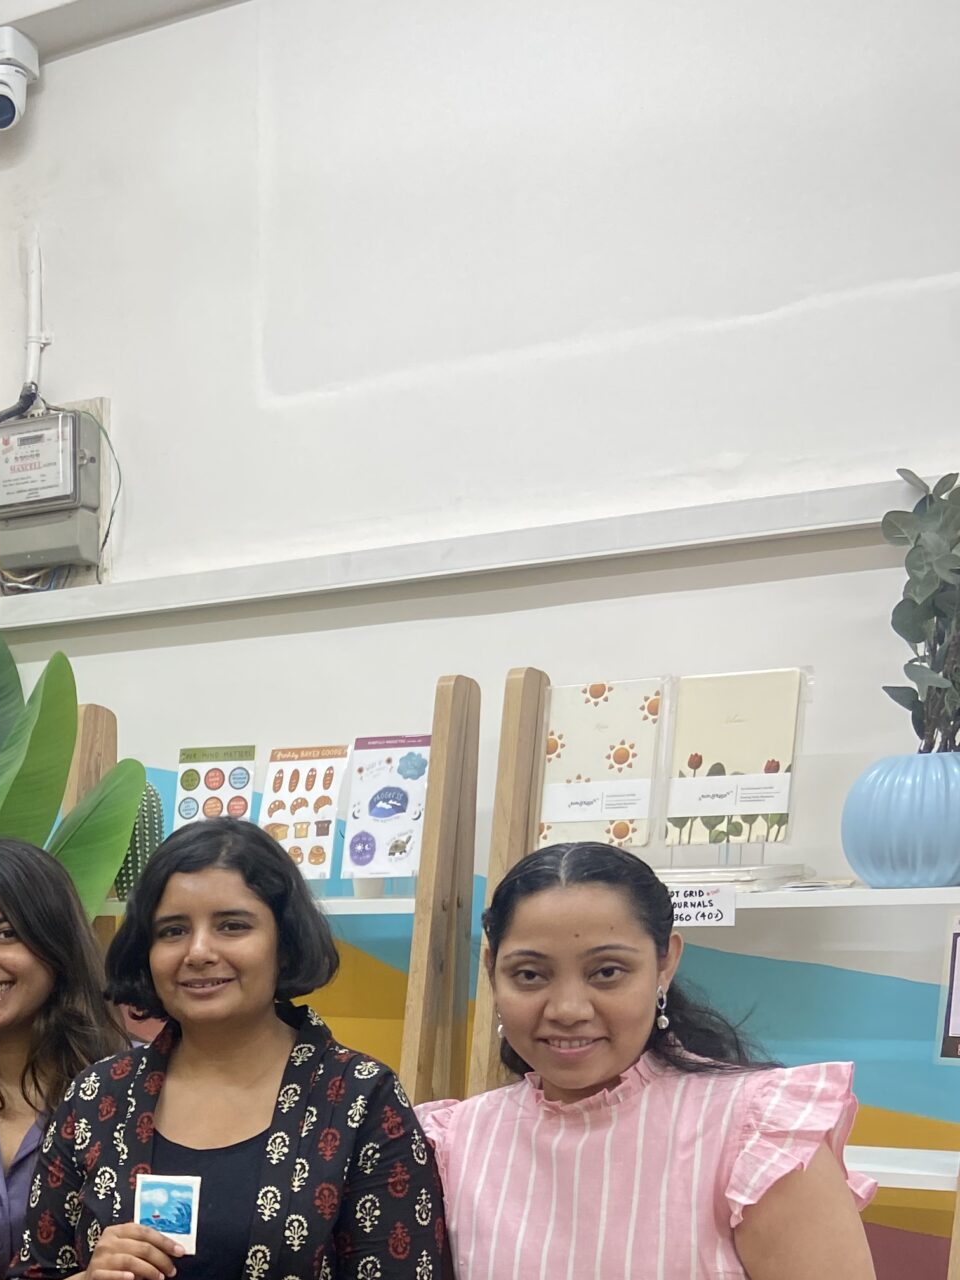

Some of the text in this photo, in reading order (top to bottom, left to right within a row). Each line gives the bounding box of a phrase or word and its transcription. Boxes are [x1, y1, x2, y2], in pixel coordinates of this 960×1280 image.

[669, 890, 680, 898] OT
[683, 889, 705, 898] GRID
[672, 899, 714, 909] OURNALS
